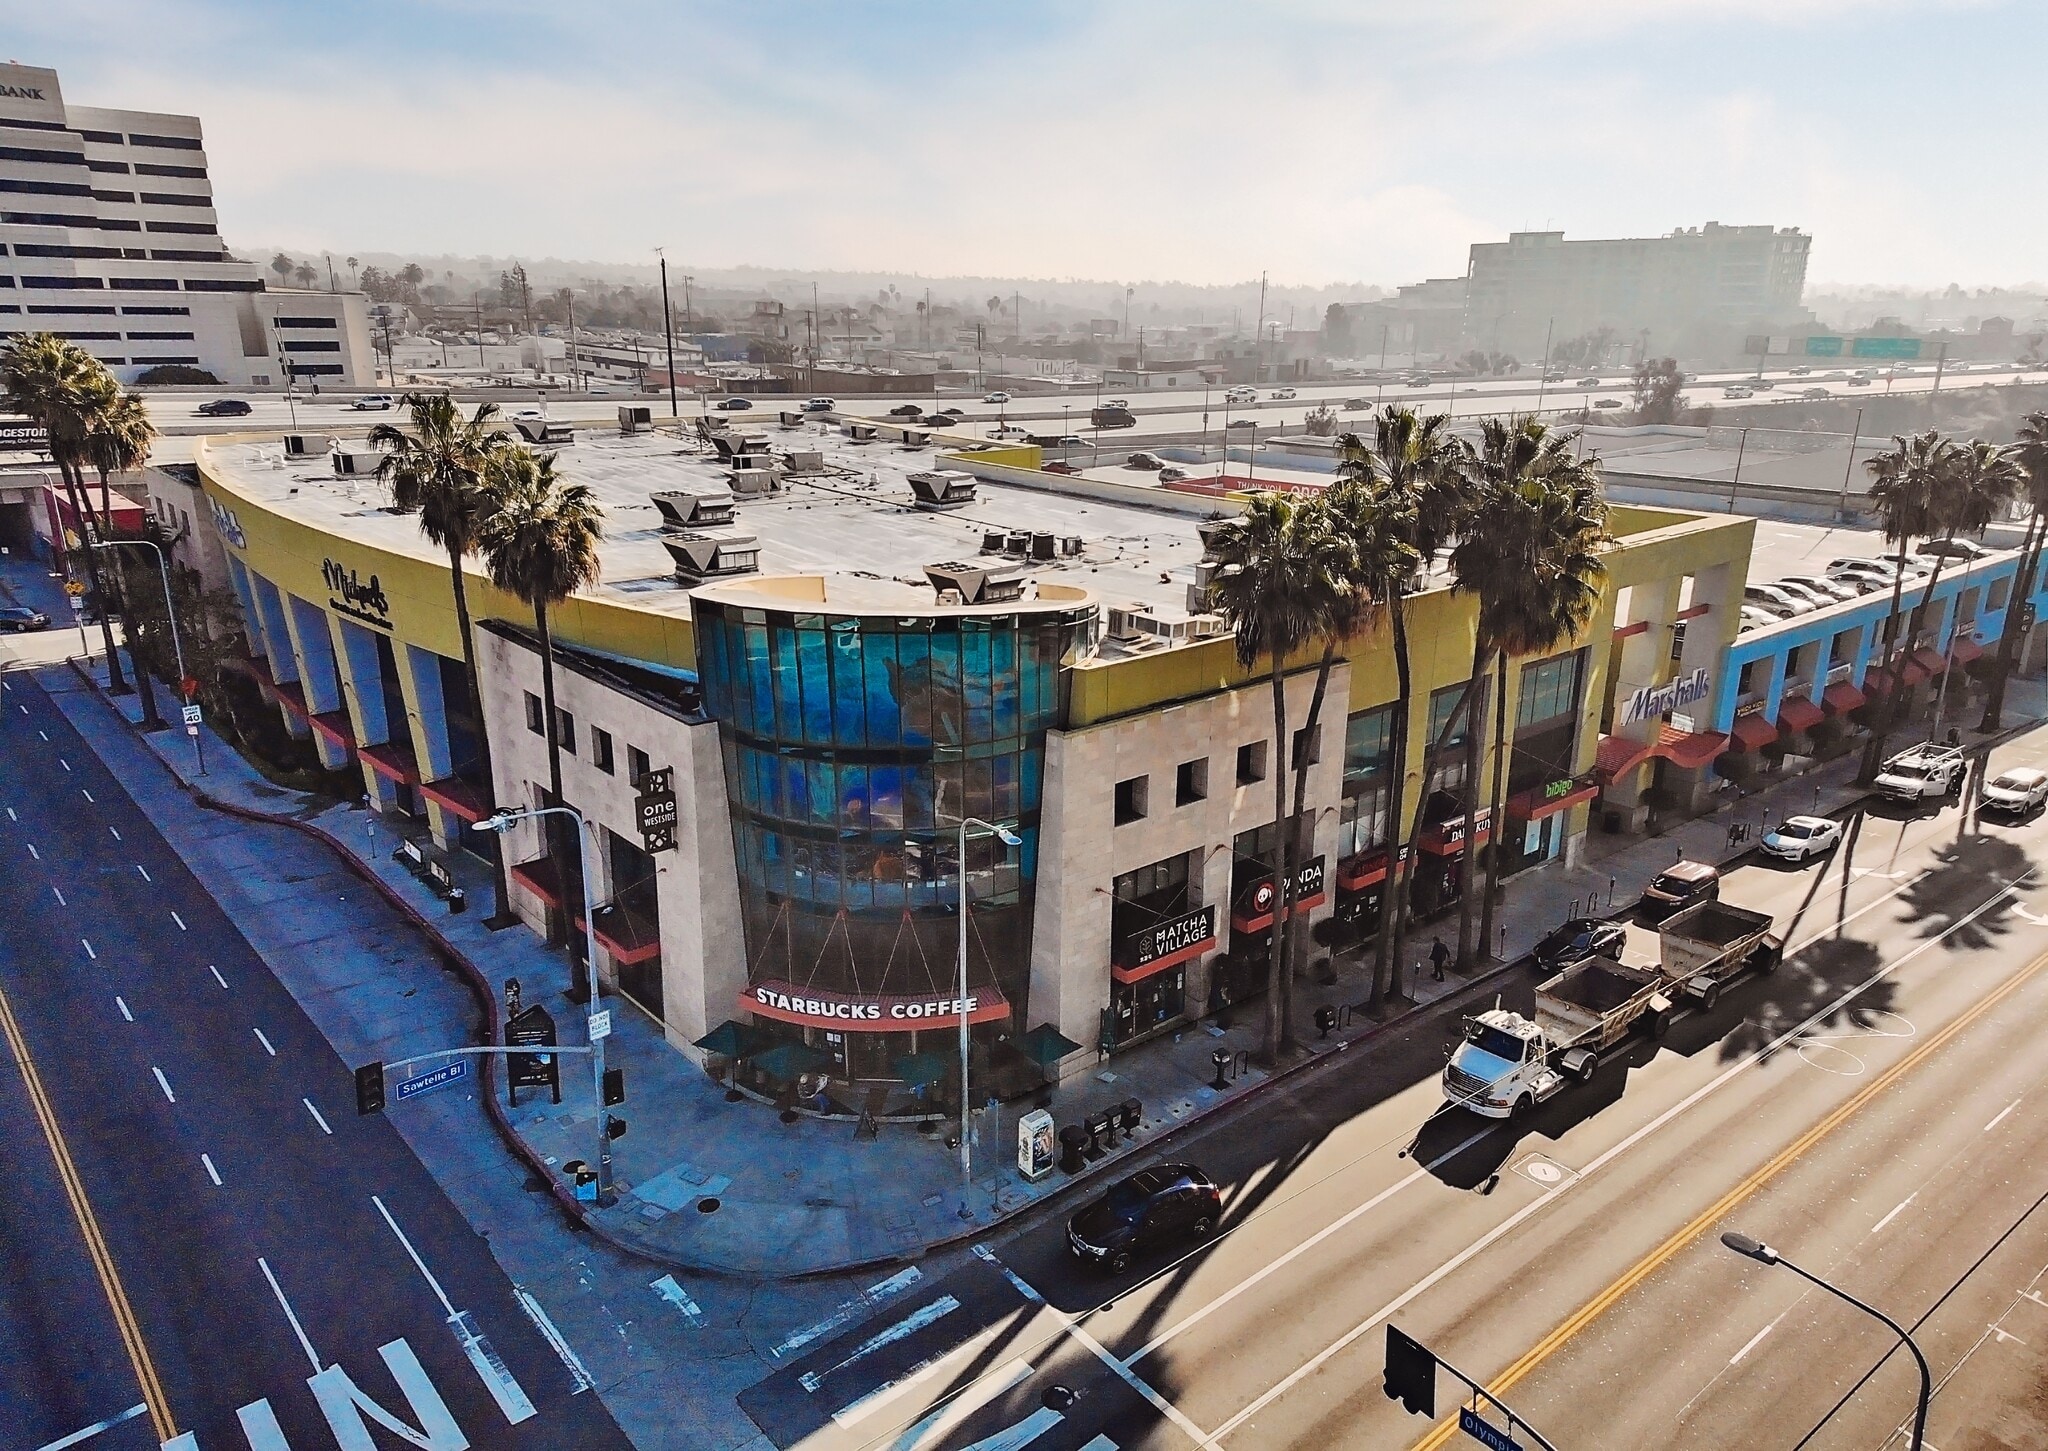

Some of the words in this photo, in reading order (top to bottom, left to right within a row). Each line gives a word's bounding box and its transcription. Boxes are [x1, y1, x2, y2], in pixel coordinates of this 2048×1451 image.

[0, 85, 46, 101] BANK
[1621, 668, 1709, 727] Marshalls
[186, 714, 200, 722] 40
[1545, 780, 1573, 798] bibigo
[644, 801, 674, 816] one
[644, 812, 676, 827] WESTSIDE
[1156, 914, 1207, 944] MATCHA
[1156, 925, 1207, 956] VILLAGE
[756, 988, 881, 1019] STARBUCKS
[890, 997, 978, 1019] COFFEE
[403, 1071, 447, 1094] Sawtelle
[1464, 1416, 1517, 1451] Olympi
